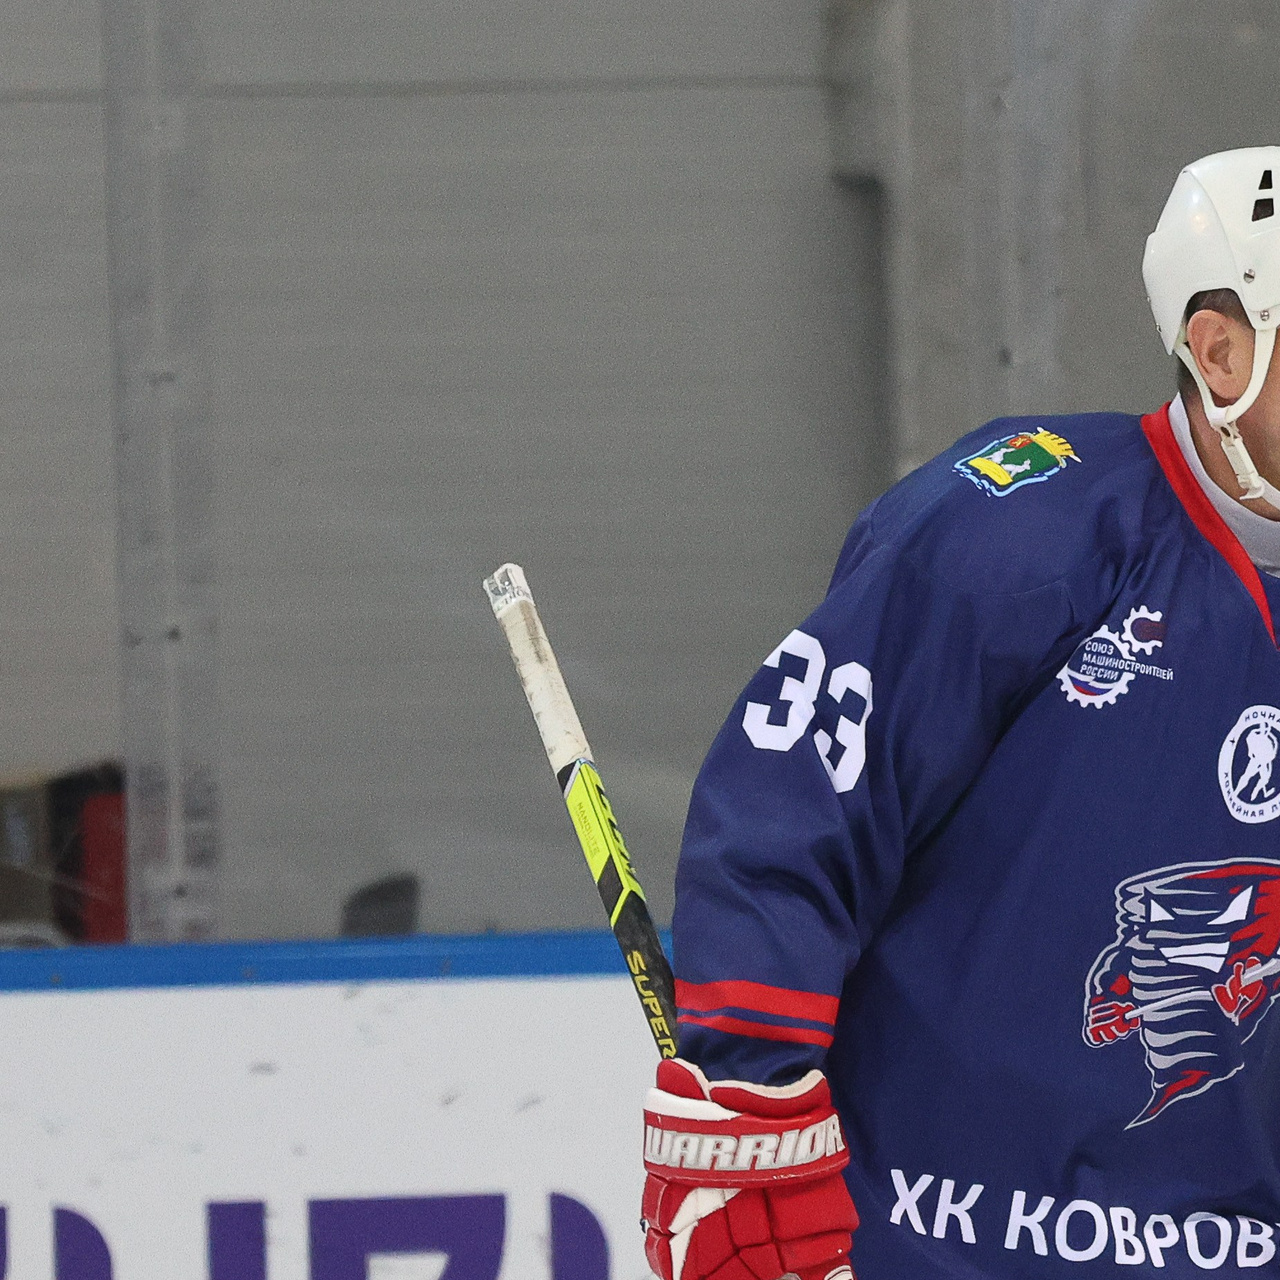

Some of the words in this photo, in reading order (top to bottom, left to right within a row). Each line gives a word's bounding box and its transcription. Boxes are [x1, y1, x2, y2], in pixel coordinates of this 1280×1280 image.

[1080, 664, 1119, 681] РОССИИ
[1085, 641, 1115, 655] СОЮЗ
[742, 628, 873, 794] 33
[626, 950, 677, 1059] SUPER
[644, 1113, 847, 1172] WARRIOR
[889, 1168, 985, 1245] ХК
